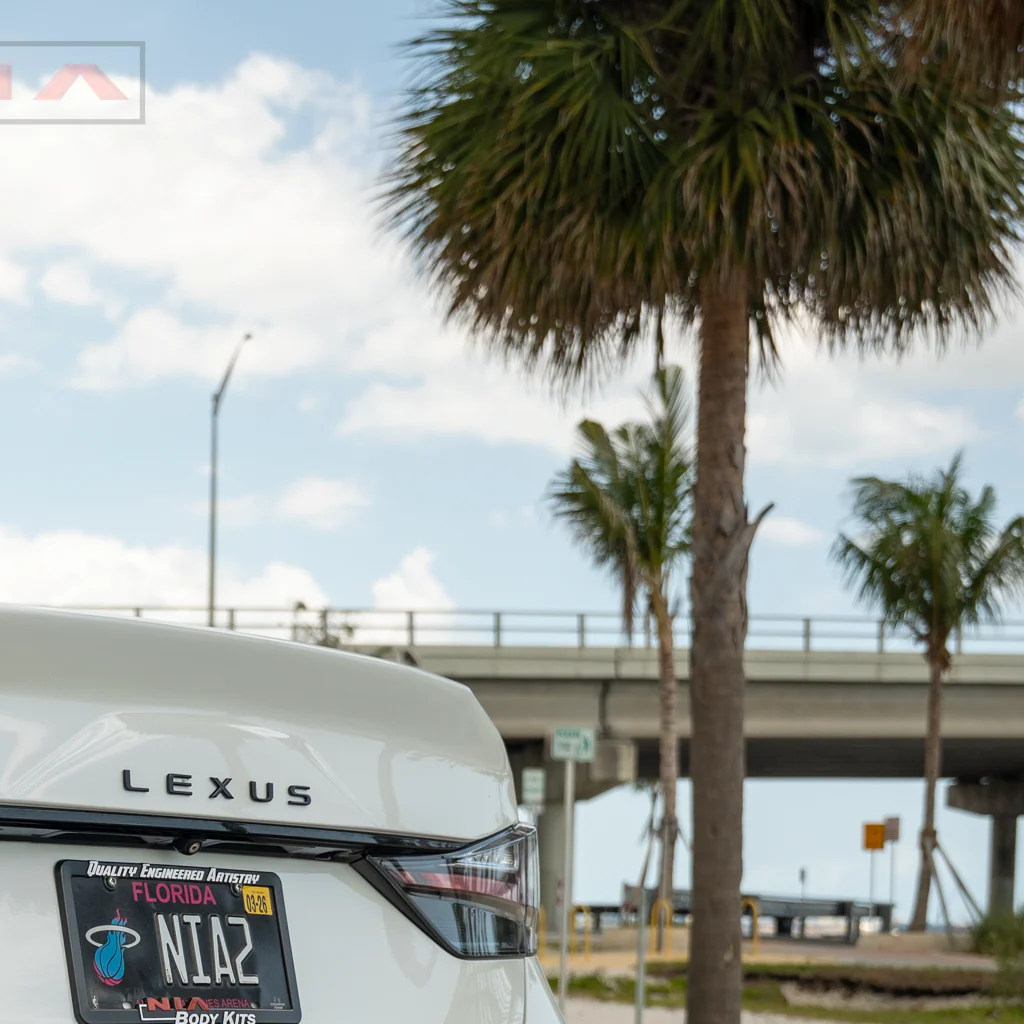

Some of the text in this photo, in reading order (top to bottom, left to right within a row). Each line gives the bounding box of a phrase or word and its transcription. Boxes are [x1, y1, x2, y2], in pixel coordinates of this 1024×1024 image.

[122, 769, 312, 806] LEXUS
[86, 860, 260, 885] QUALITY ENGINEERED ARTISTRY
[132, 881, 217, 906] FLORIDA
[246, 894, 268, 914] 03-26
[156, 913, 259, 986] NIA2
[147, 997, 209, 1011] NIA
[221, 1000, 251, 1009] ARENA
